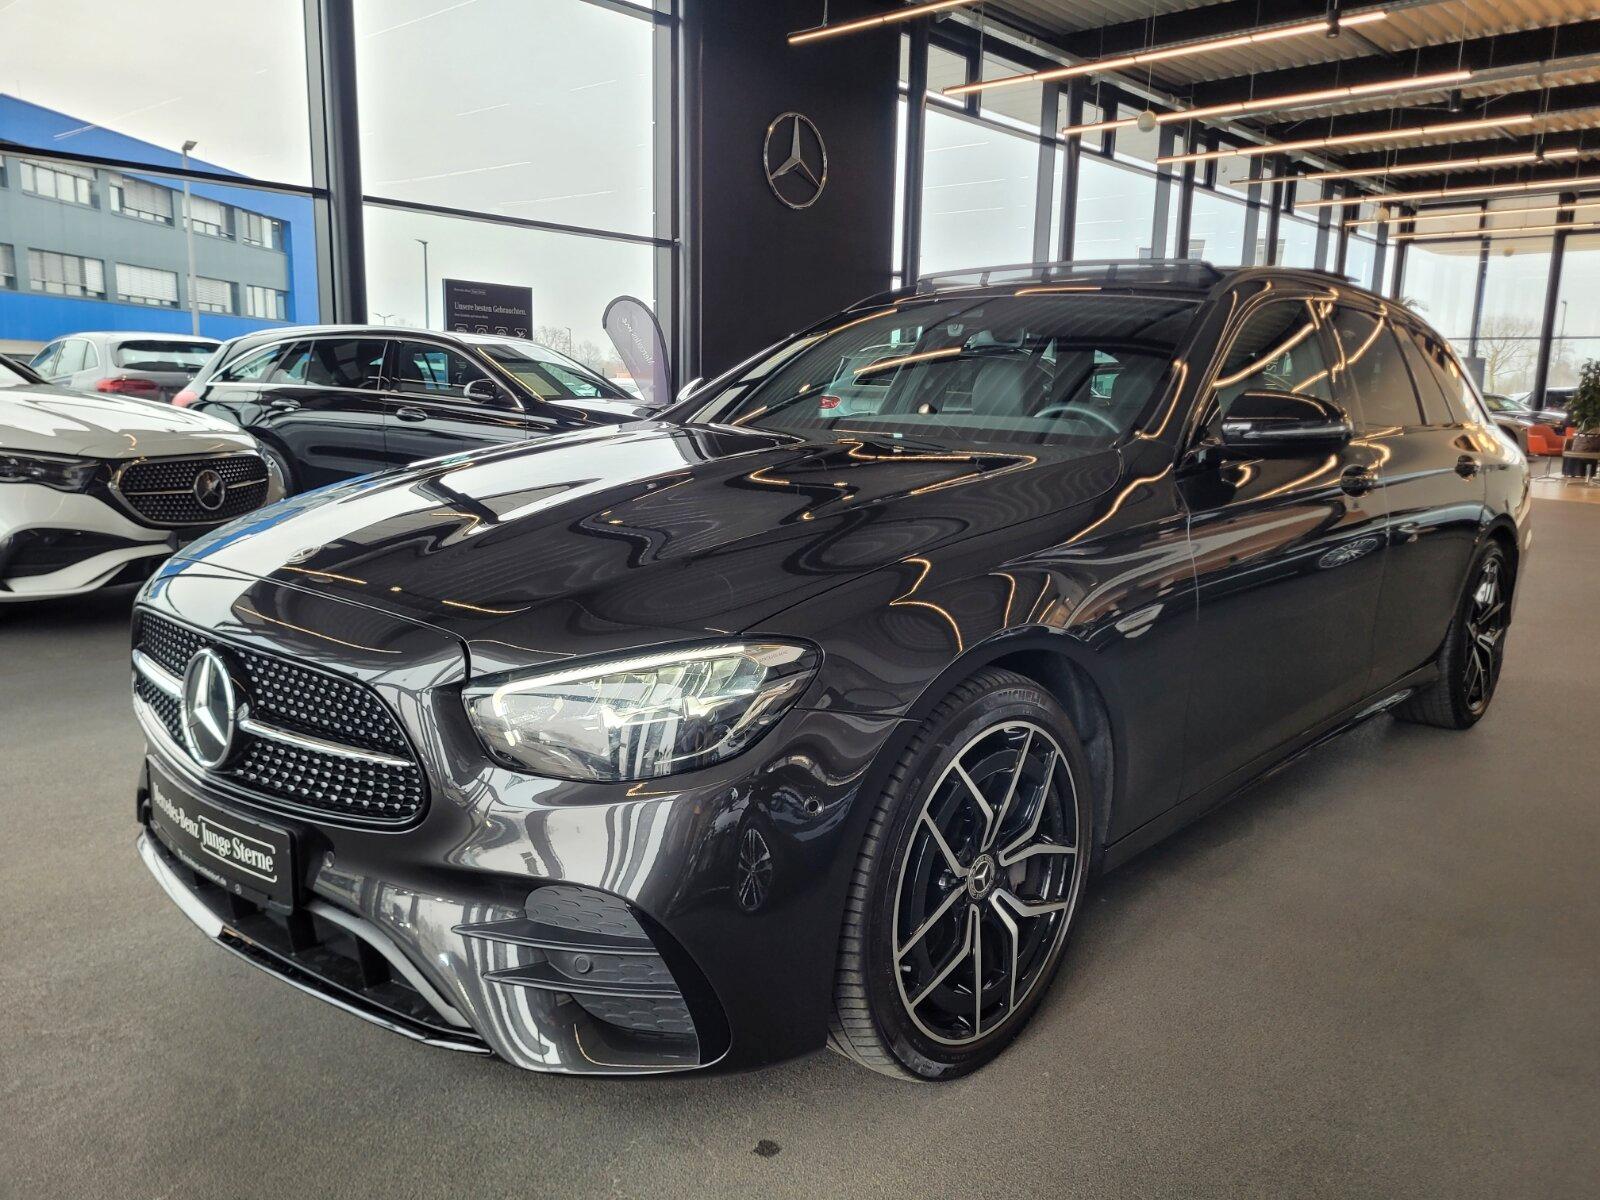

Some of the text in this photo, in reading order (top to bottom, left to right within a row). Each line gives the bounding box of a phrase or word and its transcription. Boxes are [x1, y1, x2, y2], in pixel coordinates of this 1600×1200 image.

[454, 301, 474, 311] Unsere
[474, 303, 492, 313] besten
[153, 782, 200, 839] Mercedes-Benz
[201, 822, 231, 857] Junge
[232, 837, 274, 873] Sterne
